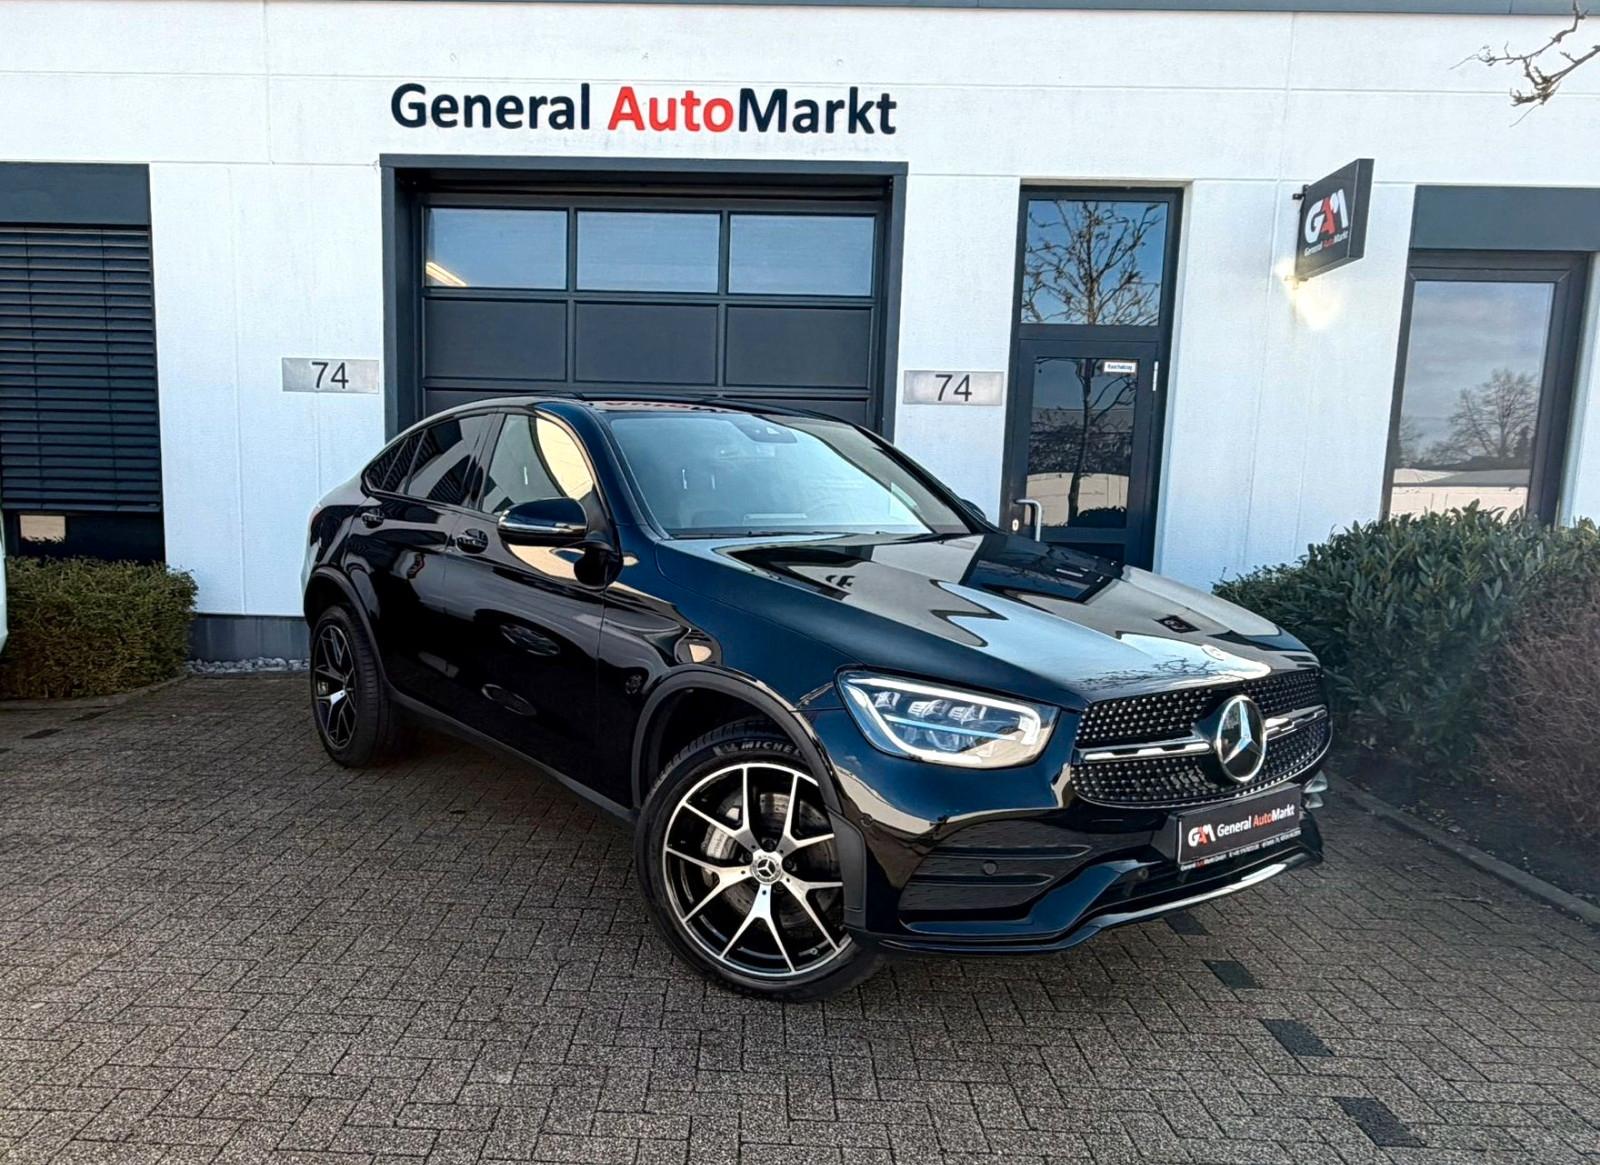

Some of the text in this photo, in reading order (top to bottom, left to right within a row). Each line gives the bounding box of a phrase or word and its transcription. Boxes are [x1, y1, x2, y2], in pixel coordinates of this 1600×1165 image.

[390, 82, 897, 134] General AutoMarkt
[311, 361, 349, 389] 74
[935, 374, 972, 402] 74
[1216, 815, 1252, 837] General
[1252, 804, 1295, 826] AutoMarkt
